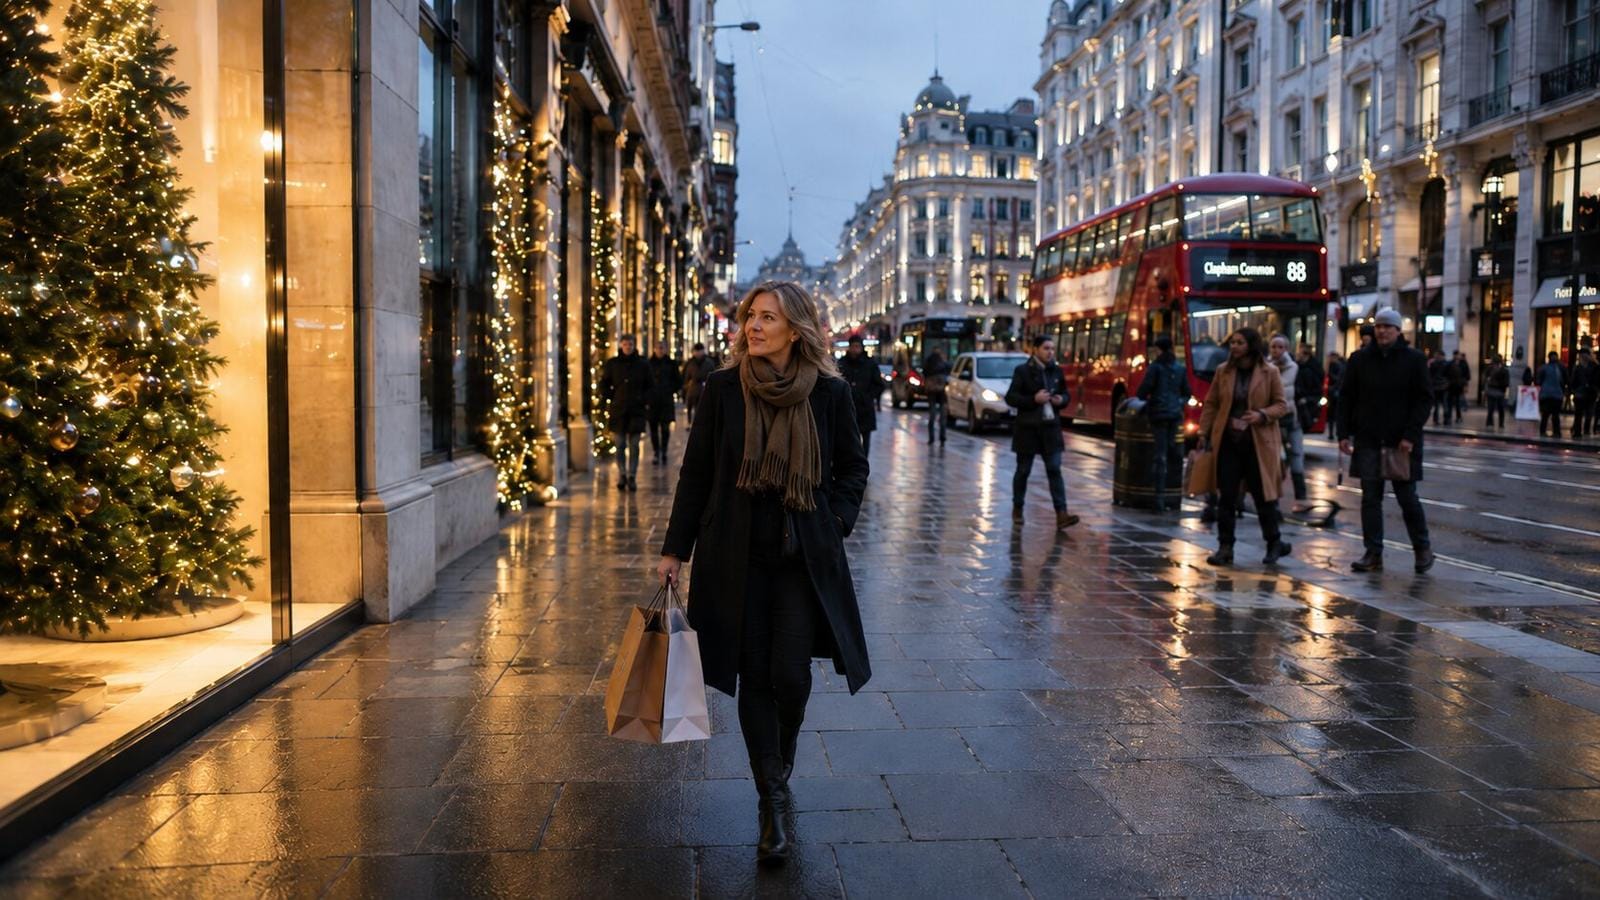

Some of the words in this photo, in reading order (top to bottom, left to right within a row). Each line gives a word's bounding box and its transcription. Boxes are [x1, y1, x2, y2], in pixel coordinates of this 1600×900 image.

[1204, 262, 1239, 277] Clapham
[1240, 262, 1275, 276] Common
[1286, 261, 1307, 282] 88
